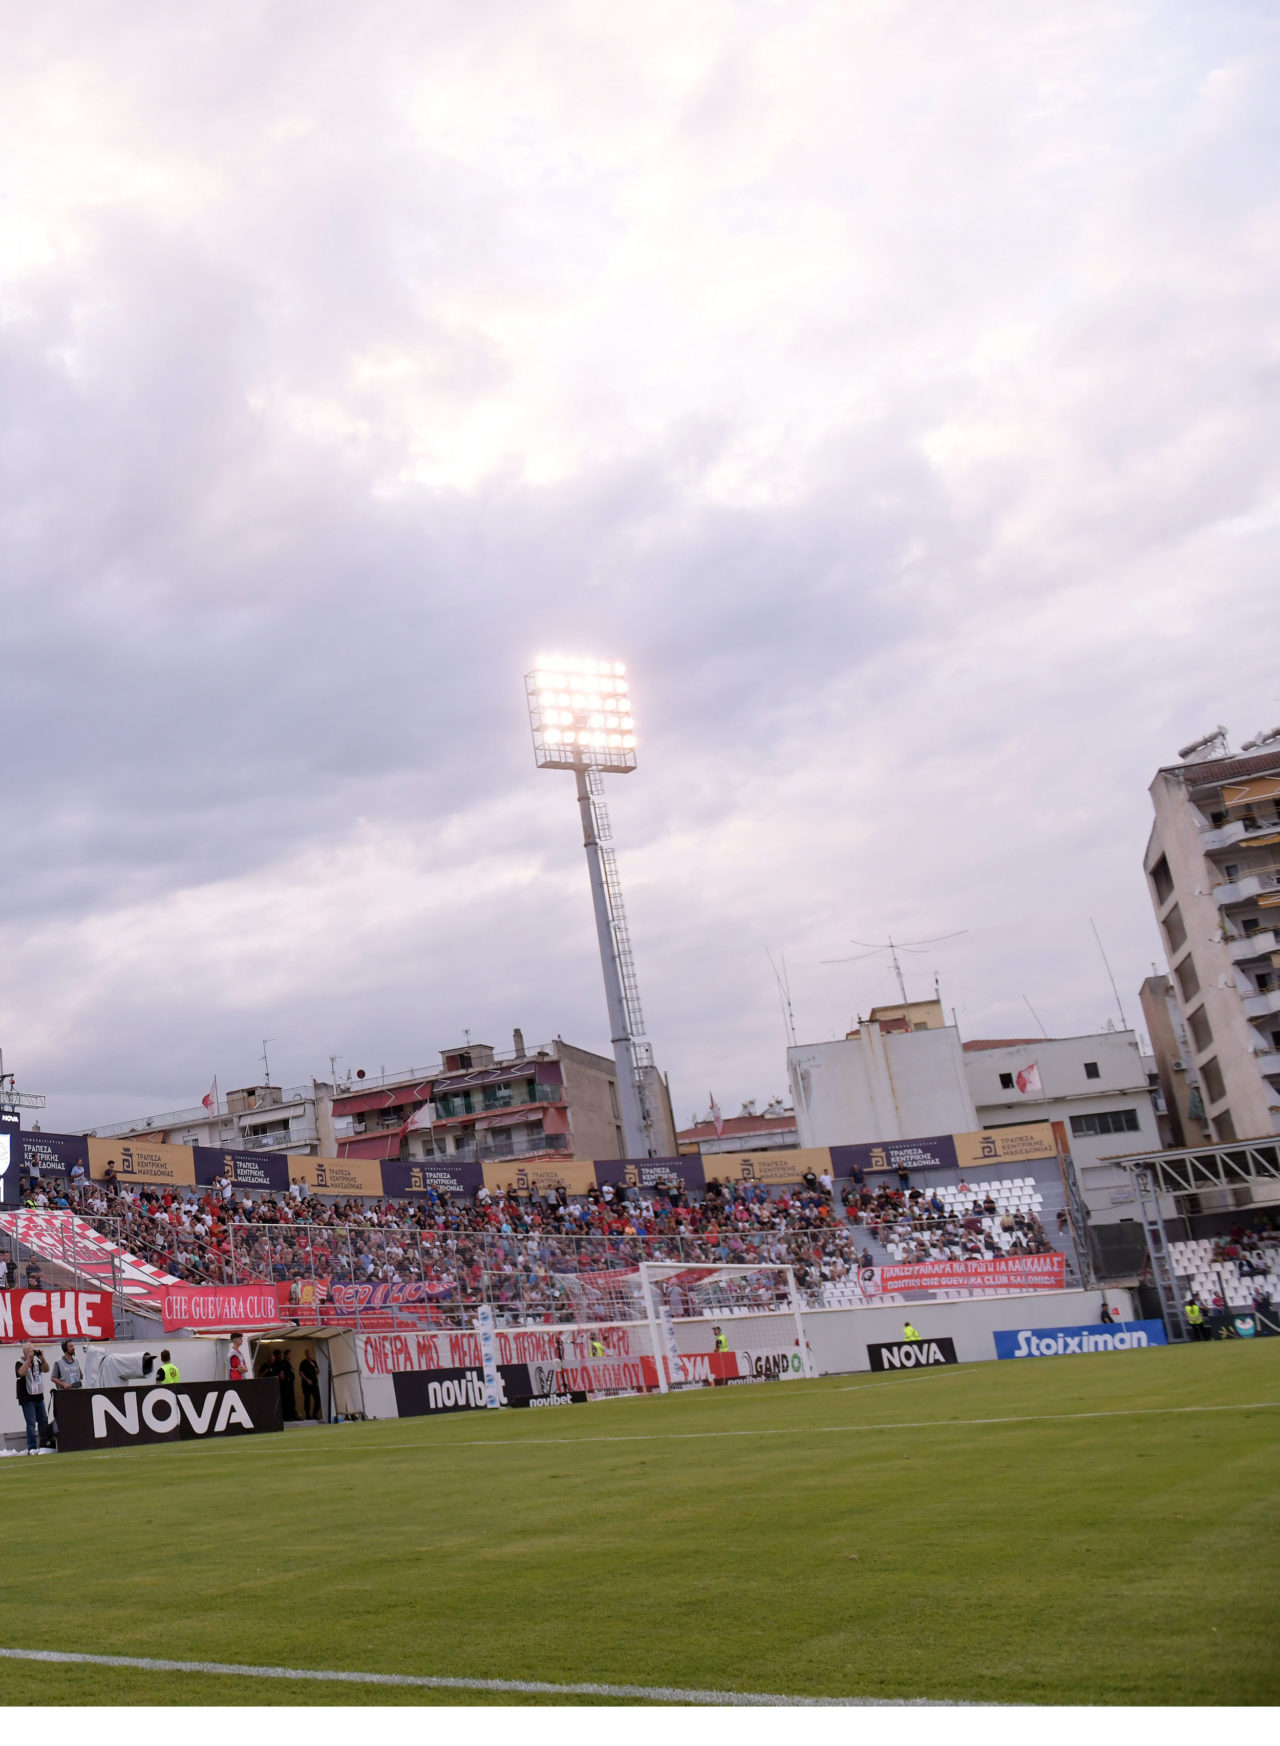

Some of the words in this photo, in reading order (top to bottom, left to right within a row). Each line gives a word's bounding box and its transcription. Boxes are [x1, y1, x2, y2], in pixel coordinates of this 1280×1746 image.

[1, 1115, 19, 1123] NOVA
[23, 1144, 52, 1153] ΤΡΑΠΕΖΑ
[889, 1148, 923, 1157] ΤΡΑΠΕΖΑ
[24, 1152, 59, 1162] ΚΕΤΡΙΚΗΣ
[136, 1153, 161, 1162] ΤΡΑΠΕΖΑ
[890, 1153, 931, 1163] ΚΕΝΤΡΙΚΗΣ
[25, 1160, 65, 1170] ΜΕΔΟΝΙΑΣ
[137, 1161, 168, 1170] ΚΕΝΤΡΙΚΗΣ
[236, 1161, 259, 1169] ΤΡΑΠΕΖΑ
[892, 1158, 941, 1169] ΜΚΕΔΟΝΙΑΣ
[137, 1169, 174, 1177] ΜΑΚΕΔΟΝΙΑΣ
[237, 1169, 264, 1177] ΚΕΝΤΡΙΚΗΣ
[237, 1176, 270, 1184] ΜΑΚΕΔΟΝΙΑΣ
[921, 1277, 939, 1286] CHE
[984, 1274, 1008, 1285] CLUB
[165, 1295, 189, 1320] CHE
[191, 1295, 245, 1320] GUEVARA
[246, 1295, 275, 1319] CLUB
[20, 1291, 102, 1338] CHE
[1015, 1330, 1148, 1358] Stoiximan
[364, 1336, 414, 1375] ΟΝΕΙΡΑ
[448, 1333, 483, 1369] ΜΕΓΑ
[881, 1342, 945, 1369] NOVA
[428, 1370, 508, 1409] novibt
[529, 1393, 573, 1408] novibet
[91, 1387, 255, 1439] NOVA
